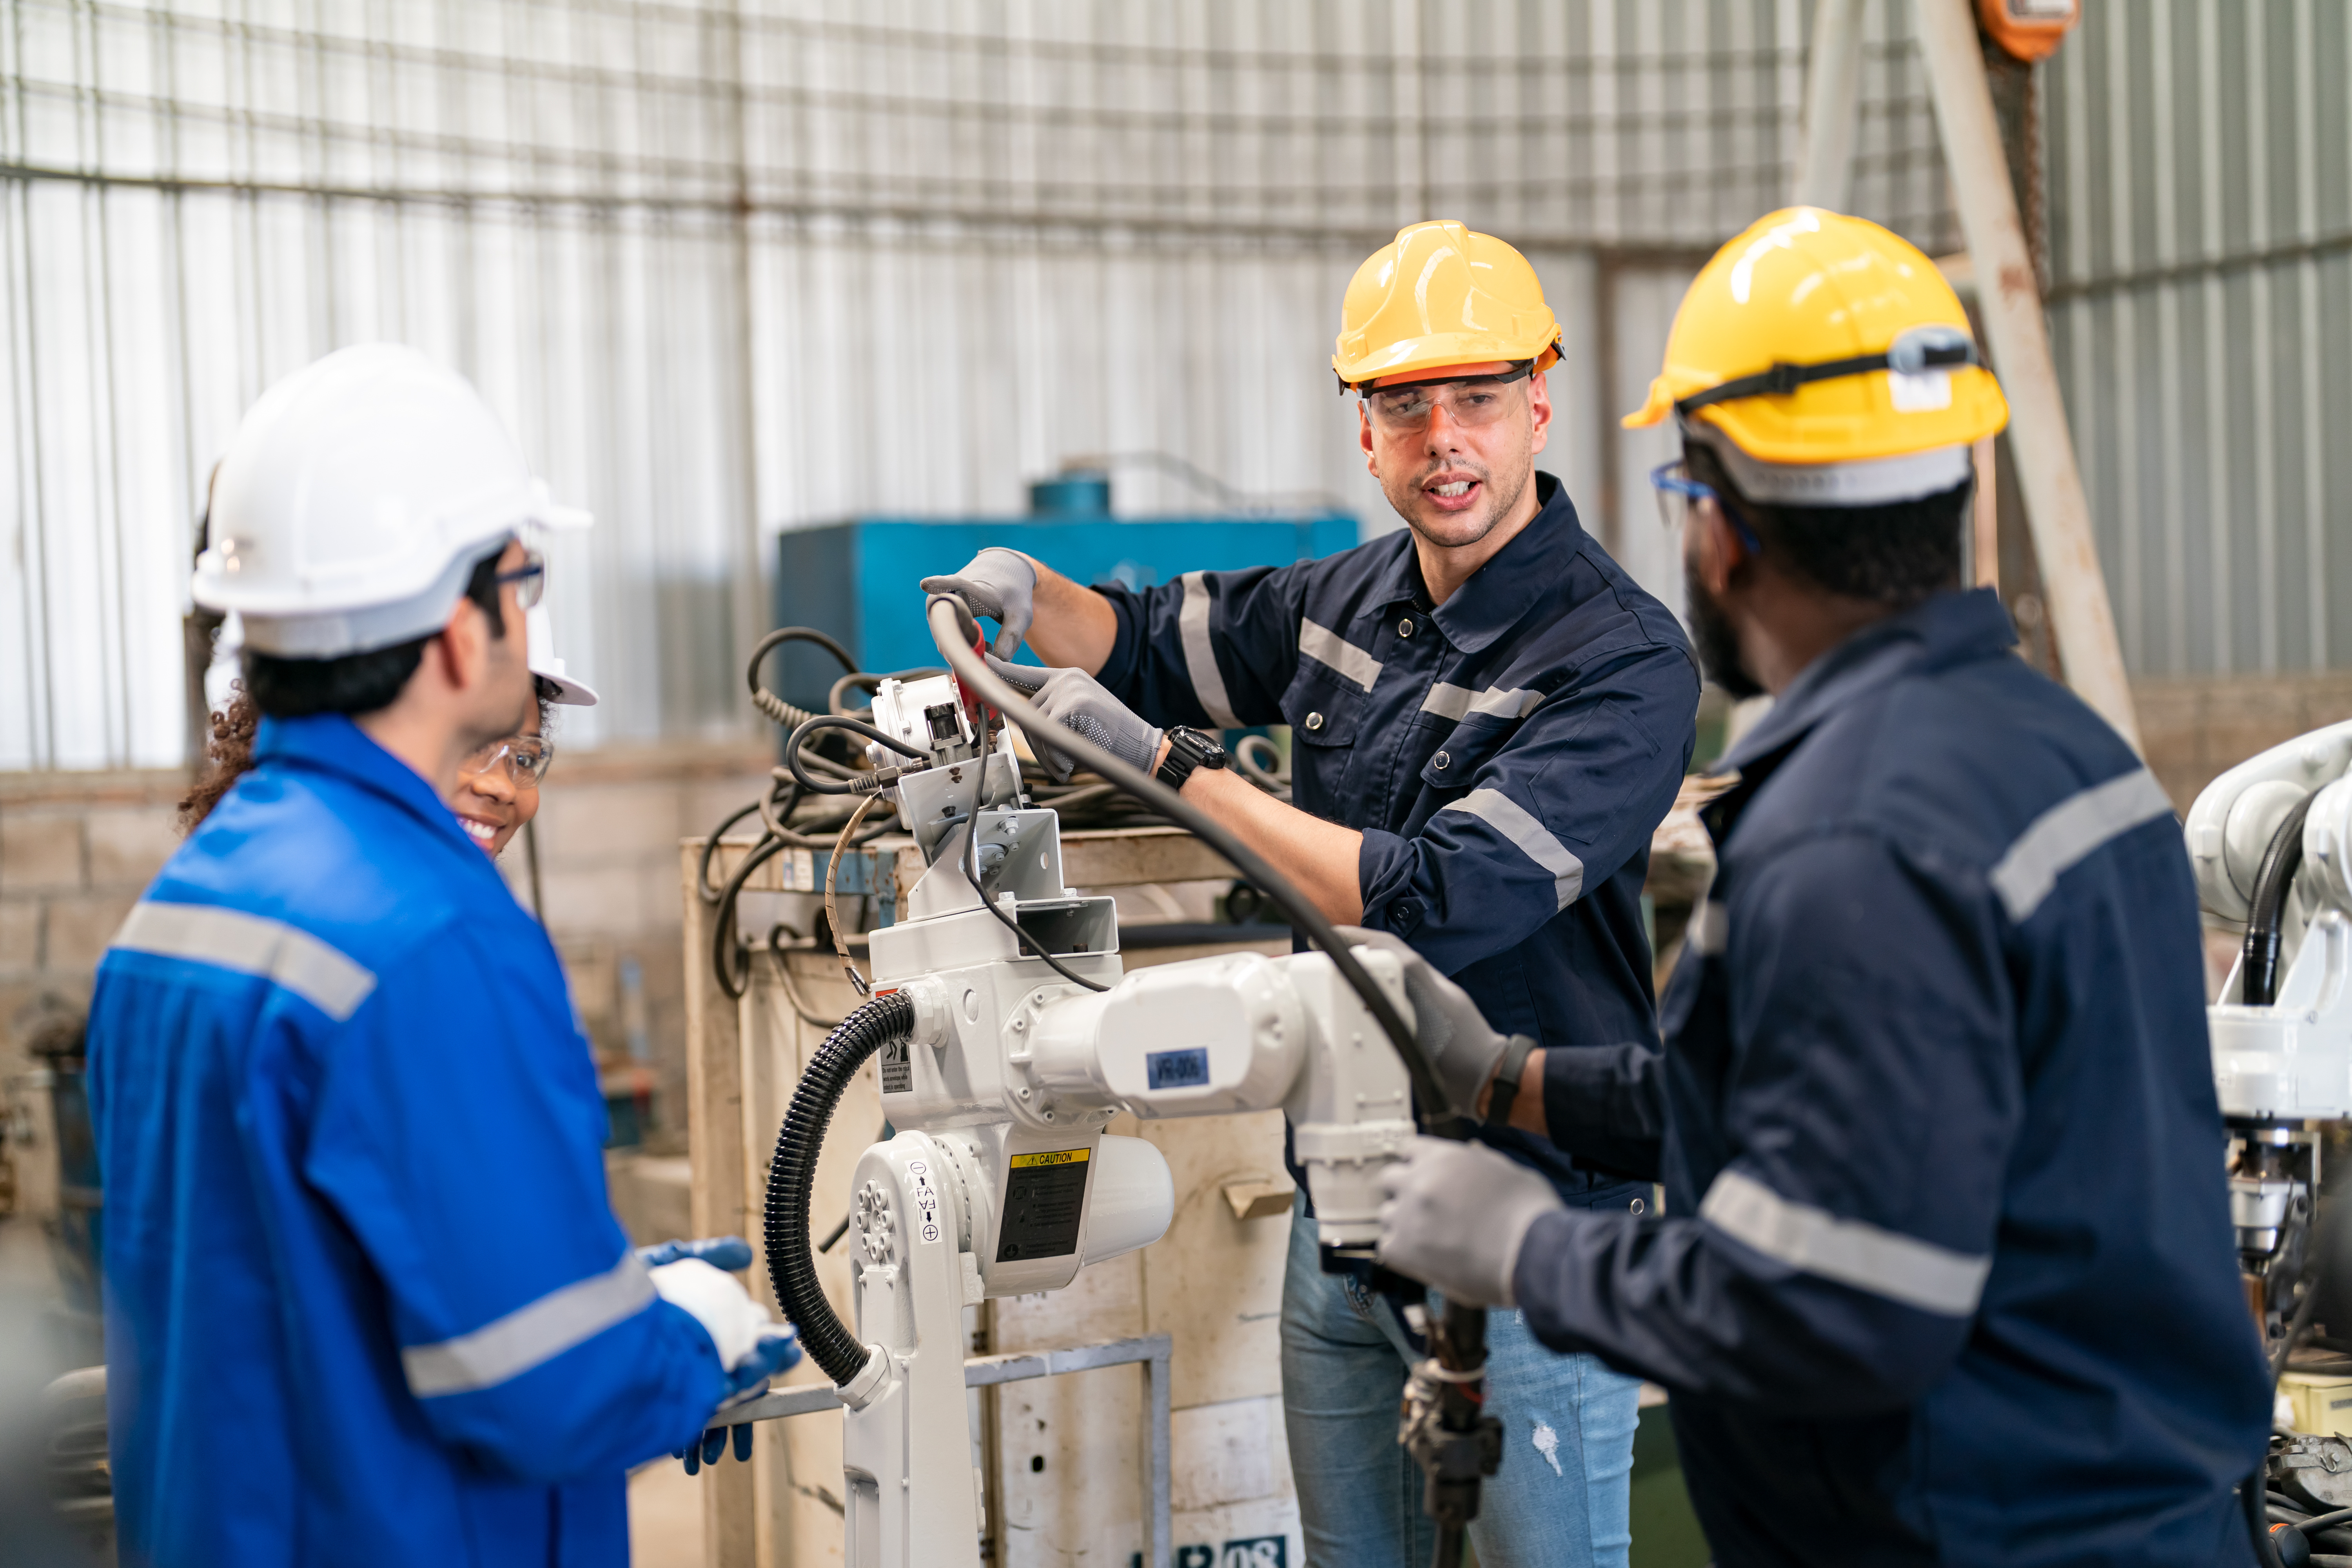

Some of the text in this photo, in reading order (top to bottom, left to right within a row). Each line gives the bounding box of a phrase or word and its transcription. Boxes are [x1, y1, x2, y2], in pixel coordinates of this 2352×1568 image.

[1040, 1153, 1072, 1164] CAUTION
[916, 1187, 934, 1197] FA
[918, 1199, 936, 1210] FA
